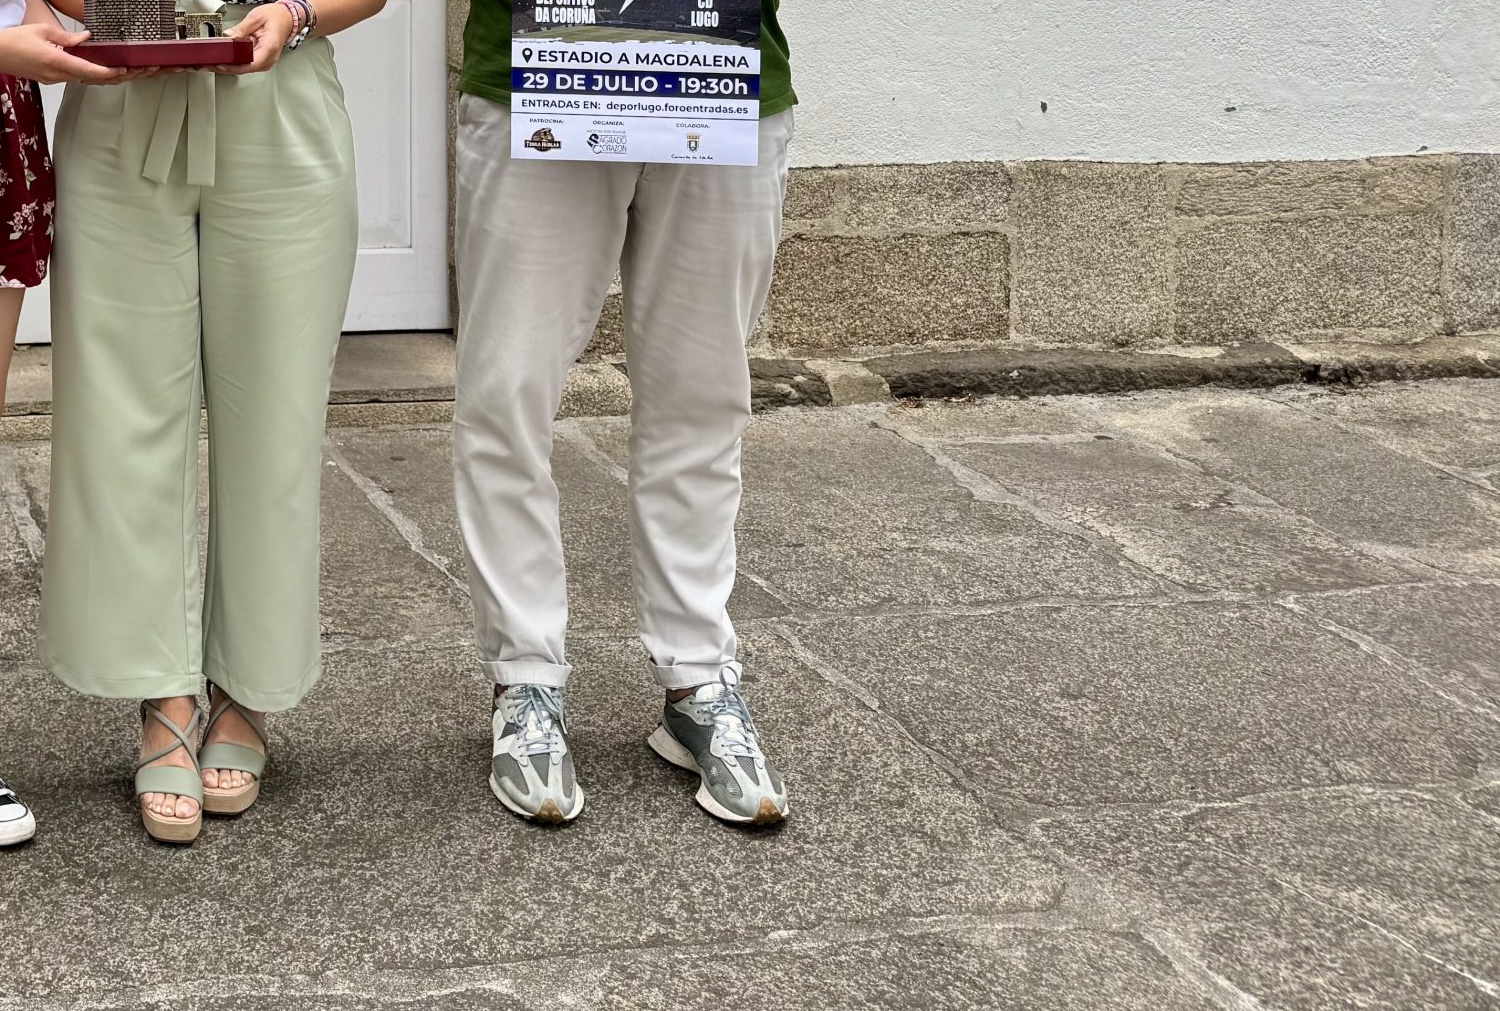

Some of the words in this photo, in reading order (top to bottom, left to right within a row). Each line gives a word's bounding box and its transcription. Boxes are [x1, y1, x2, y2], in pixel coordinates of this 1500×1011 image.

[535, 6, 550, 23] DA
[551, 4, 596, 24] CORUÑA
[690, 10, 719, 27] LUGO
[537, 50, 613, 65] ESTADIO
[617, 52, 630, 65] A
[635, 52, 749, 69] MAGDALENA
[522, 72, 549, 90] 29
[555, 74, 586, 90] DE
[591, 75, 658, 92] JULIO
[678, 76, 748, 95] 19:30h
[521, 99, 580, 110] ENTRADAS
[583, 101, 601, 110] EN:
[606, 101, 749, 115] deporlugo.foroentradas.es
